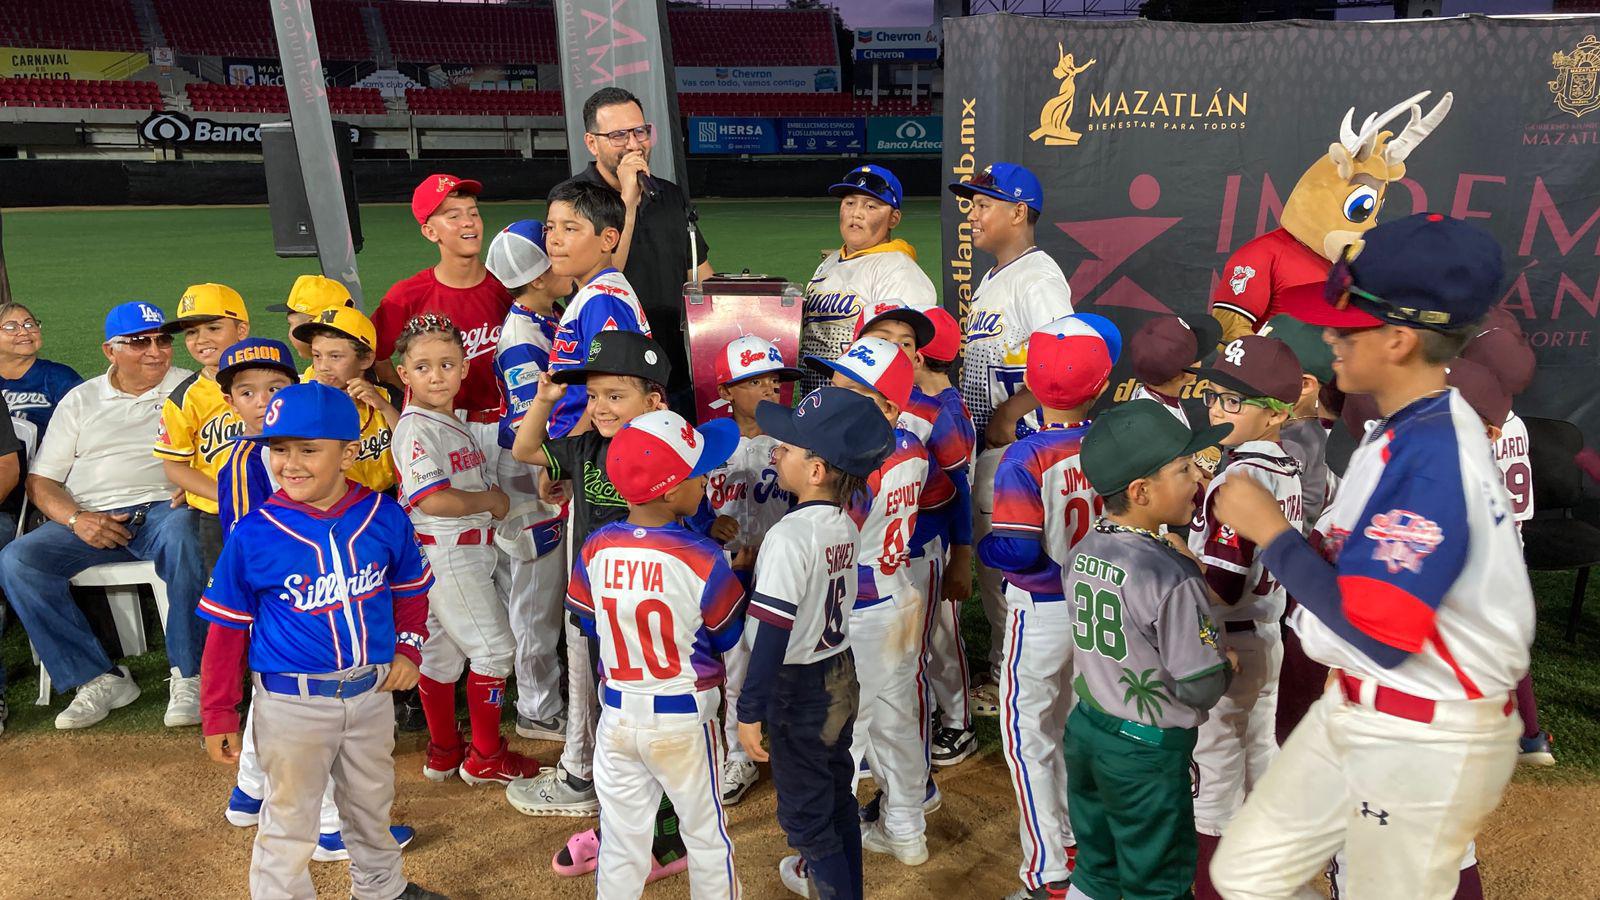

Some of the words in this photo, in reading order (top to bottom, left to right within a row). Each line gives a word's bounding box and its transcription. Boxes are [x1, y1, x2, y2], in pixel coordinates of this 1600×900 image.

[876, 31, 921, 42] Chevron
[12, 54, 69, 67] CARNAVAL
[863, 50, 905, 59] Chevron
[732, 69, 772, 79] Chevron
[682, 79, 698, 87] Vas
[717, 79, 739, 88] todo,
[743, 79, 770, 87] vamos
[772, 79, 806, 88] contigo
[1088, 87, 1248, 118] MAZATLÁN
[720, 125, 762, 135] HERSA
[1088, 120, 1156, 131] BIENESTAR
[1163, 122, 1195, 131] PARA
[1203, 121, 1246, 131] TODOS
[877, 140, 908, 149] Banco
[320, 309, 338, 324] N
[228, 345, 281, 366] LEGION
[740, 349, 766, 367] San
[848, 345, 876, 367] Jose
[264, 398, 284, 427] S
[710, 473, 748, 509] San
[603, 558, 665, 593] LEYVA
[1072, 580, 1129, 663] 38
[601, 596, 682, 681] 10
